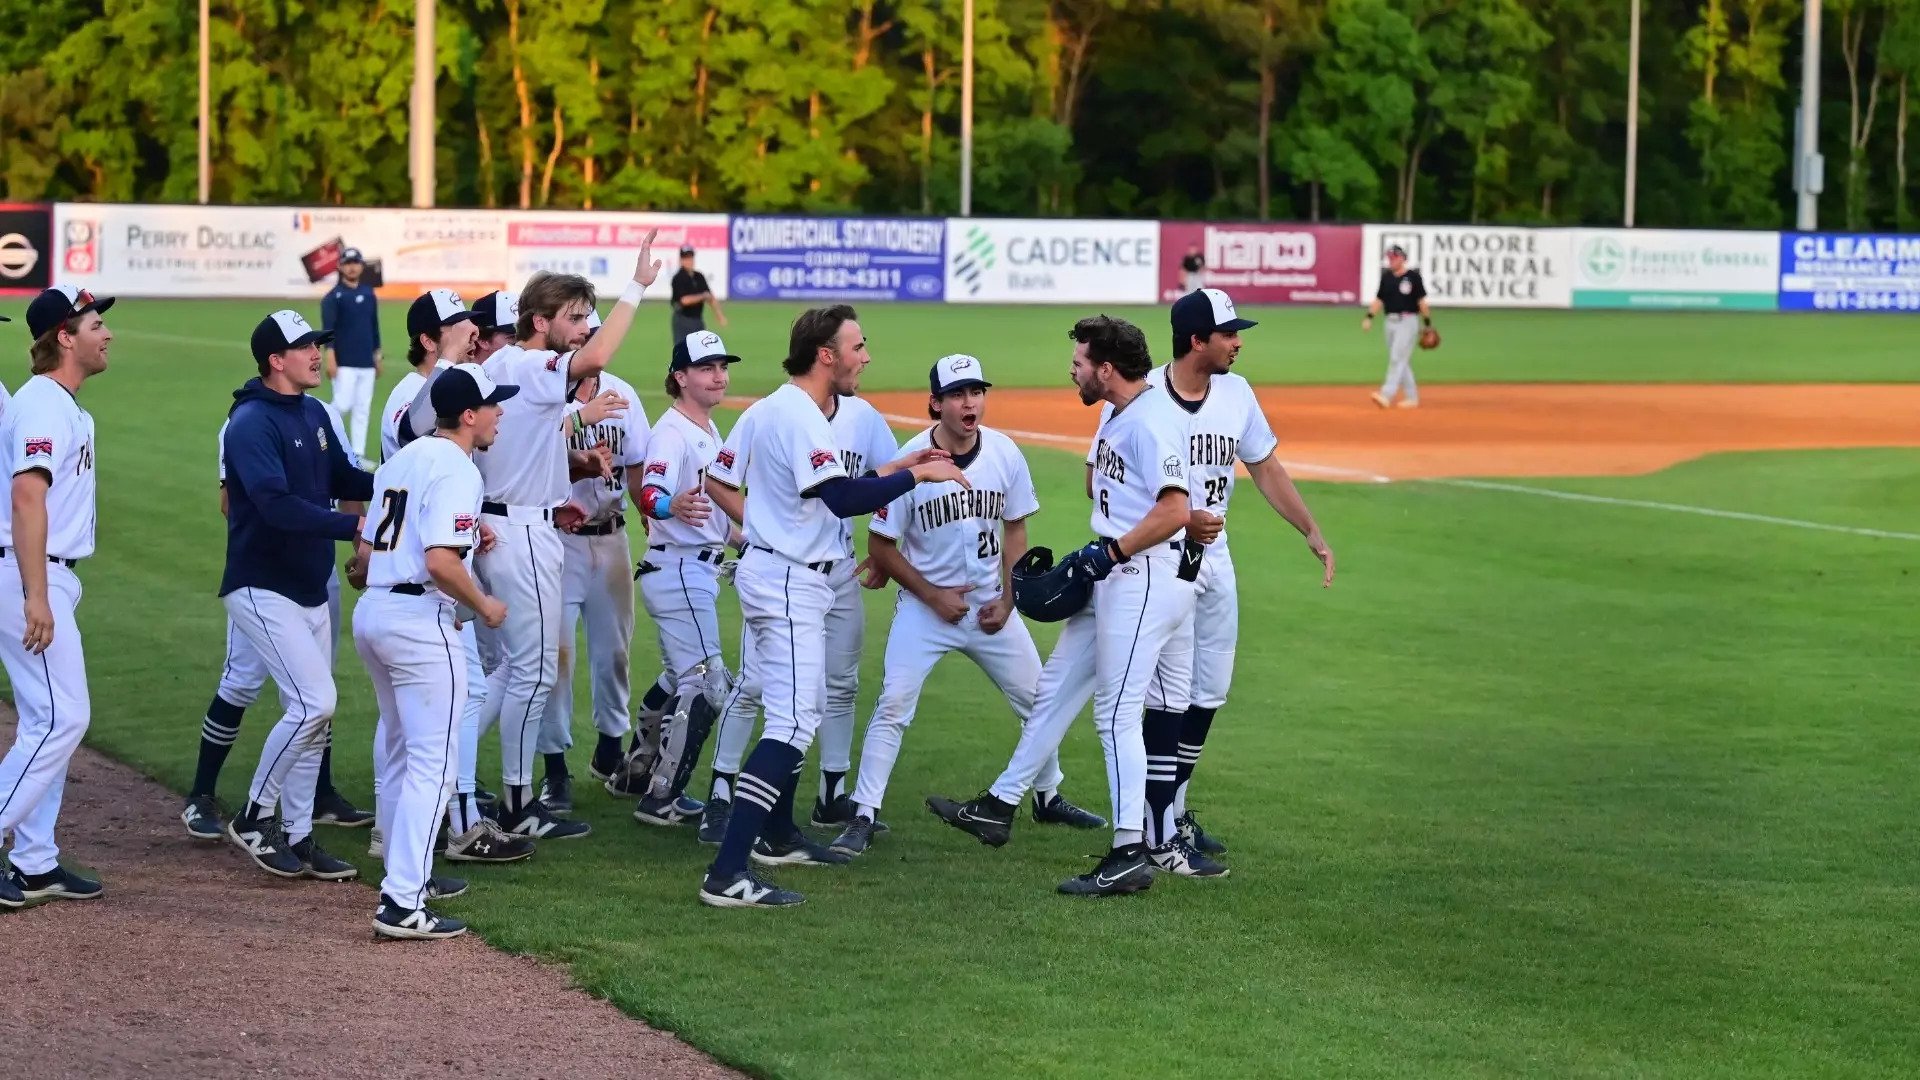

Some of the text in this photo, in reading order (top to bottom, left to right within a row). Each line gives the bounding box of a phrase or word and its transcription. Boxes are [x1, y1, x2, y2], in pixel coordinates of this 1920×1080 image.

[732, 217, 944, 255] COMMERCIAL STATIONERY
[1433, 233, 1539, 254] MOORE
[1007, 237, 1153, 266] CADENCE
[1431, 257, 1557, 276] FUNERAL
[1008, 272, 1055, 290] Bank
[1432, 278, 1540, 298] SERVICE
[1099, 489, 1110, 519] 6
[373, 488, 409, 552] 21
